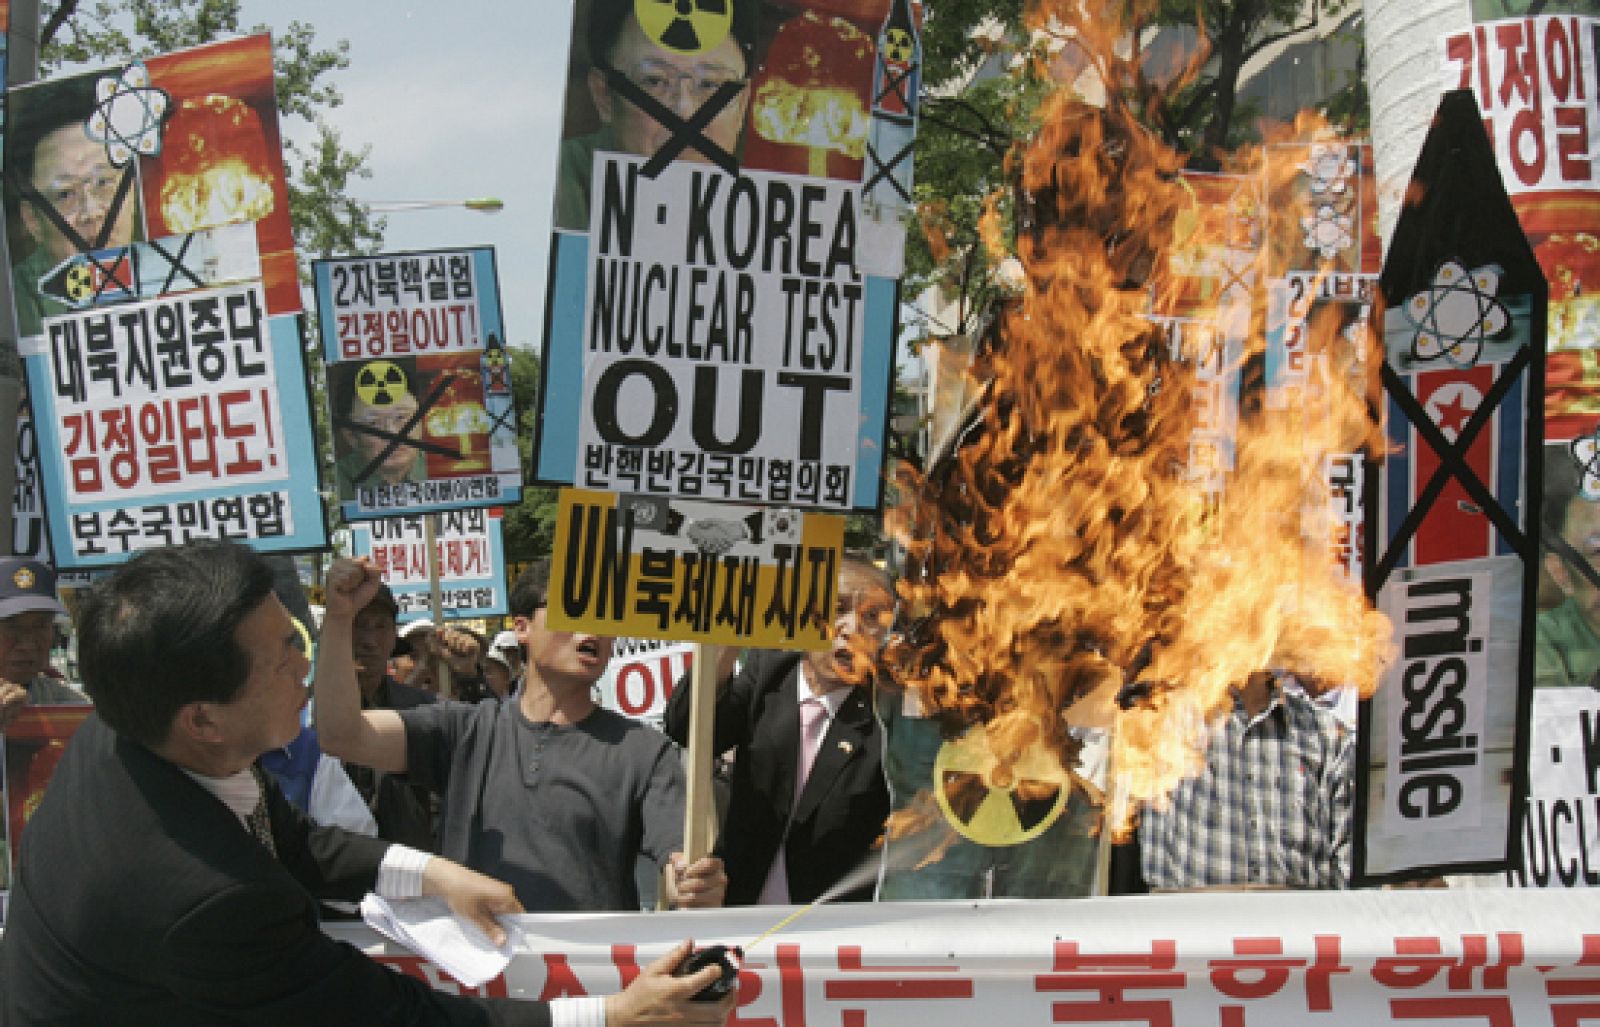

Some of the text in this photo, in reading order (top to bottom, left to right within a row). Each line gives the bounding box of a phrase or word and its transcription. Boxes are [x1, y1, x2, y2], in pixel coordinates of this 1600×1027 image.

[50, 290, 266, 402] 대북지원중단
[337, 304, 478, 358] 김정일OUT!
[590, 258, 862, 373] NUCLEAR TEST
[63, 388, 278, 493] 김정일타도!
[592, 358, 853, 461] OUT
[72, 490, 286, 556] 보수국민연합
[585, 444, 851, 507] 반핵반김국민협의회
[1398, 577, 1485, 819] missile
